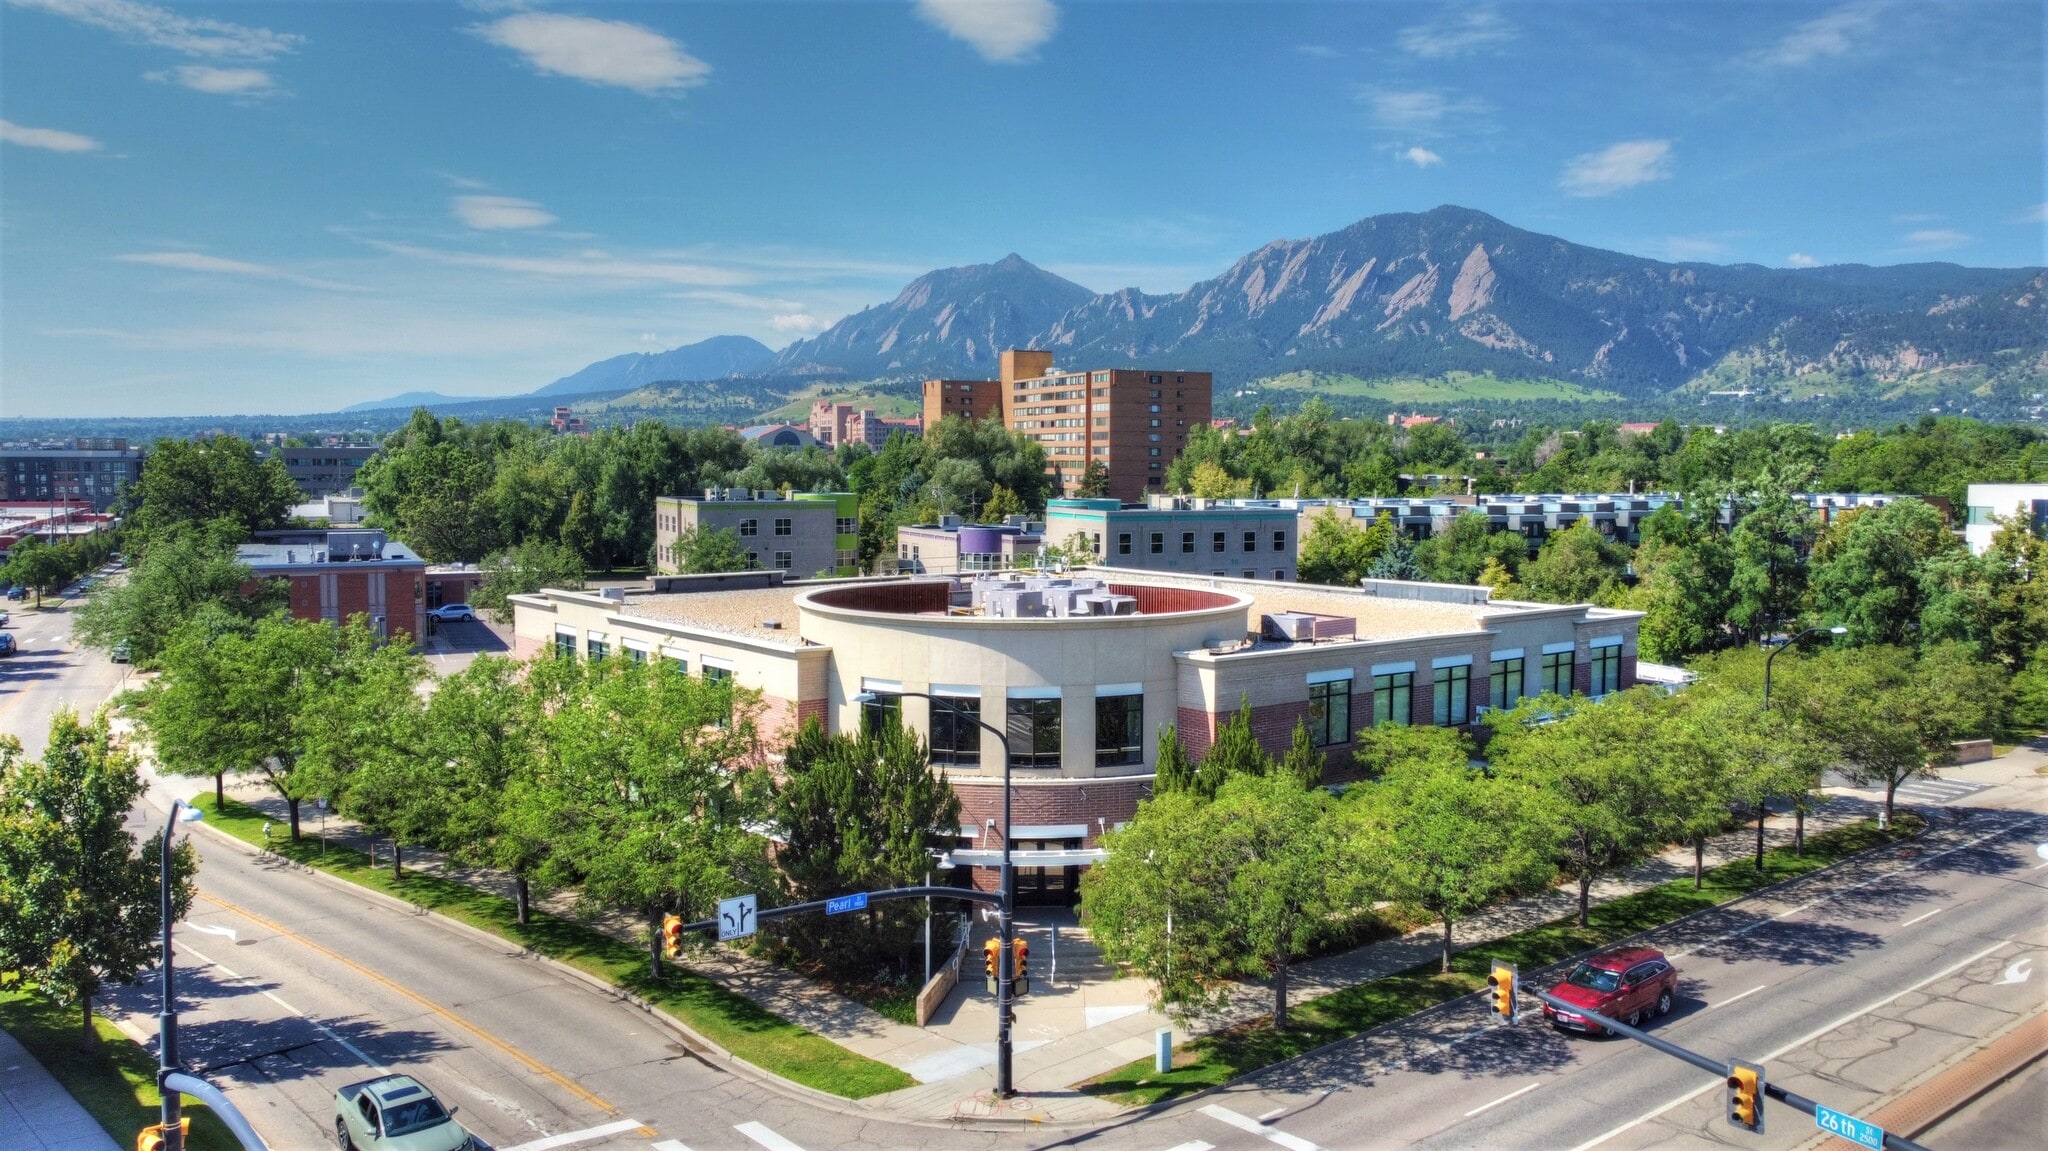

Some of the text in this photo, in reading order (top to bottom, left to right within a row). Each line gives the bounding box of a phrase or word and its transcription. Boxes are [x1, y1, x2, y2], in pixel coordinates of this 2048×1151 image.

[828, 898, 851, 912] Pearl
[721, 929, 737, 938] ONLY
[1865, 1125, 1874, 1136] St
[1859, 1133, 1878, 1146] 2500
